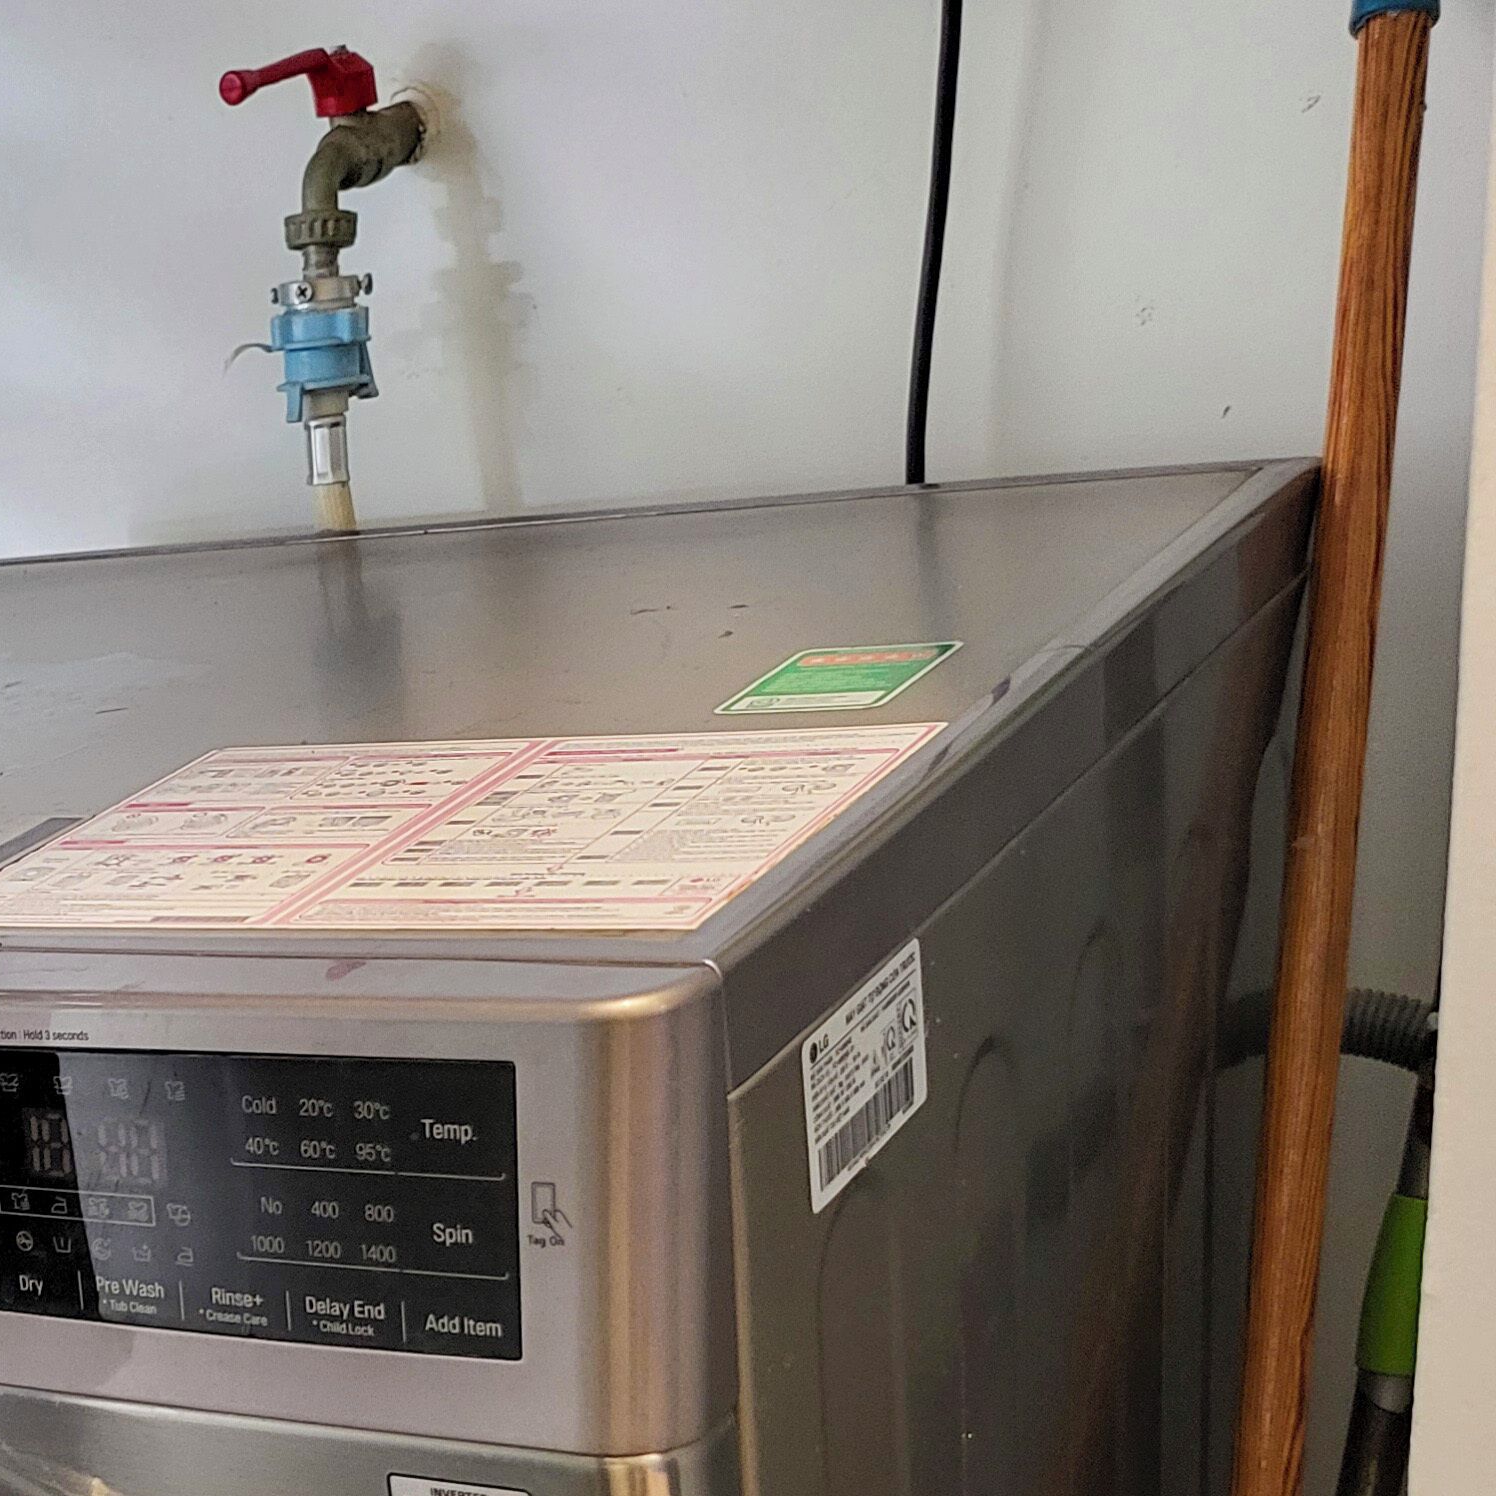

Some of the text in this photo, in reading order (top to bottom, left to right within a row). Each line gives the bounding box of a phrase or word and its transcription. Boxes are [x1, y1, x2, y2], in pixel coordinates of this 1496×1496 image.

[23, 1030, 43, 1041] Hold
[45, 1030, 50, 1041] 3
[53, 1030, 89, 1041] seconds
[818, 1033, 830, 1053] LG
[241, 1095, 277, 1114] Cold
[261, 1197, 394, 1222] No 400 800
[432, 1223, 473, 1247] Spin
[527, 1234, 565, 1248] Tag On
[251, 1235, 396, 1262] 1000 1200 1400
[19, 1275, 44, 1295] Dry
[96, 1276, 165, 1298] Pre Wash
[110, 1300, 157, 1314] Tub Clean
[211, 1288, 264, 1308] Rinse+
[305, 1296, 385, 1320] Delay End
[243, 1312, 268, 1326] Care
[319, 1320, 374, 1336] Child Lock
[425, 1314, 502, 1338] Add Item
